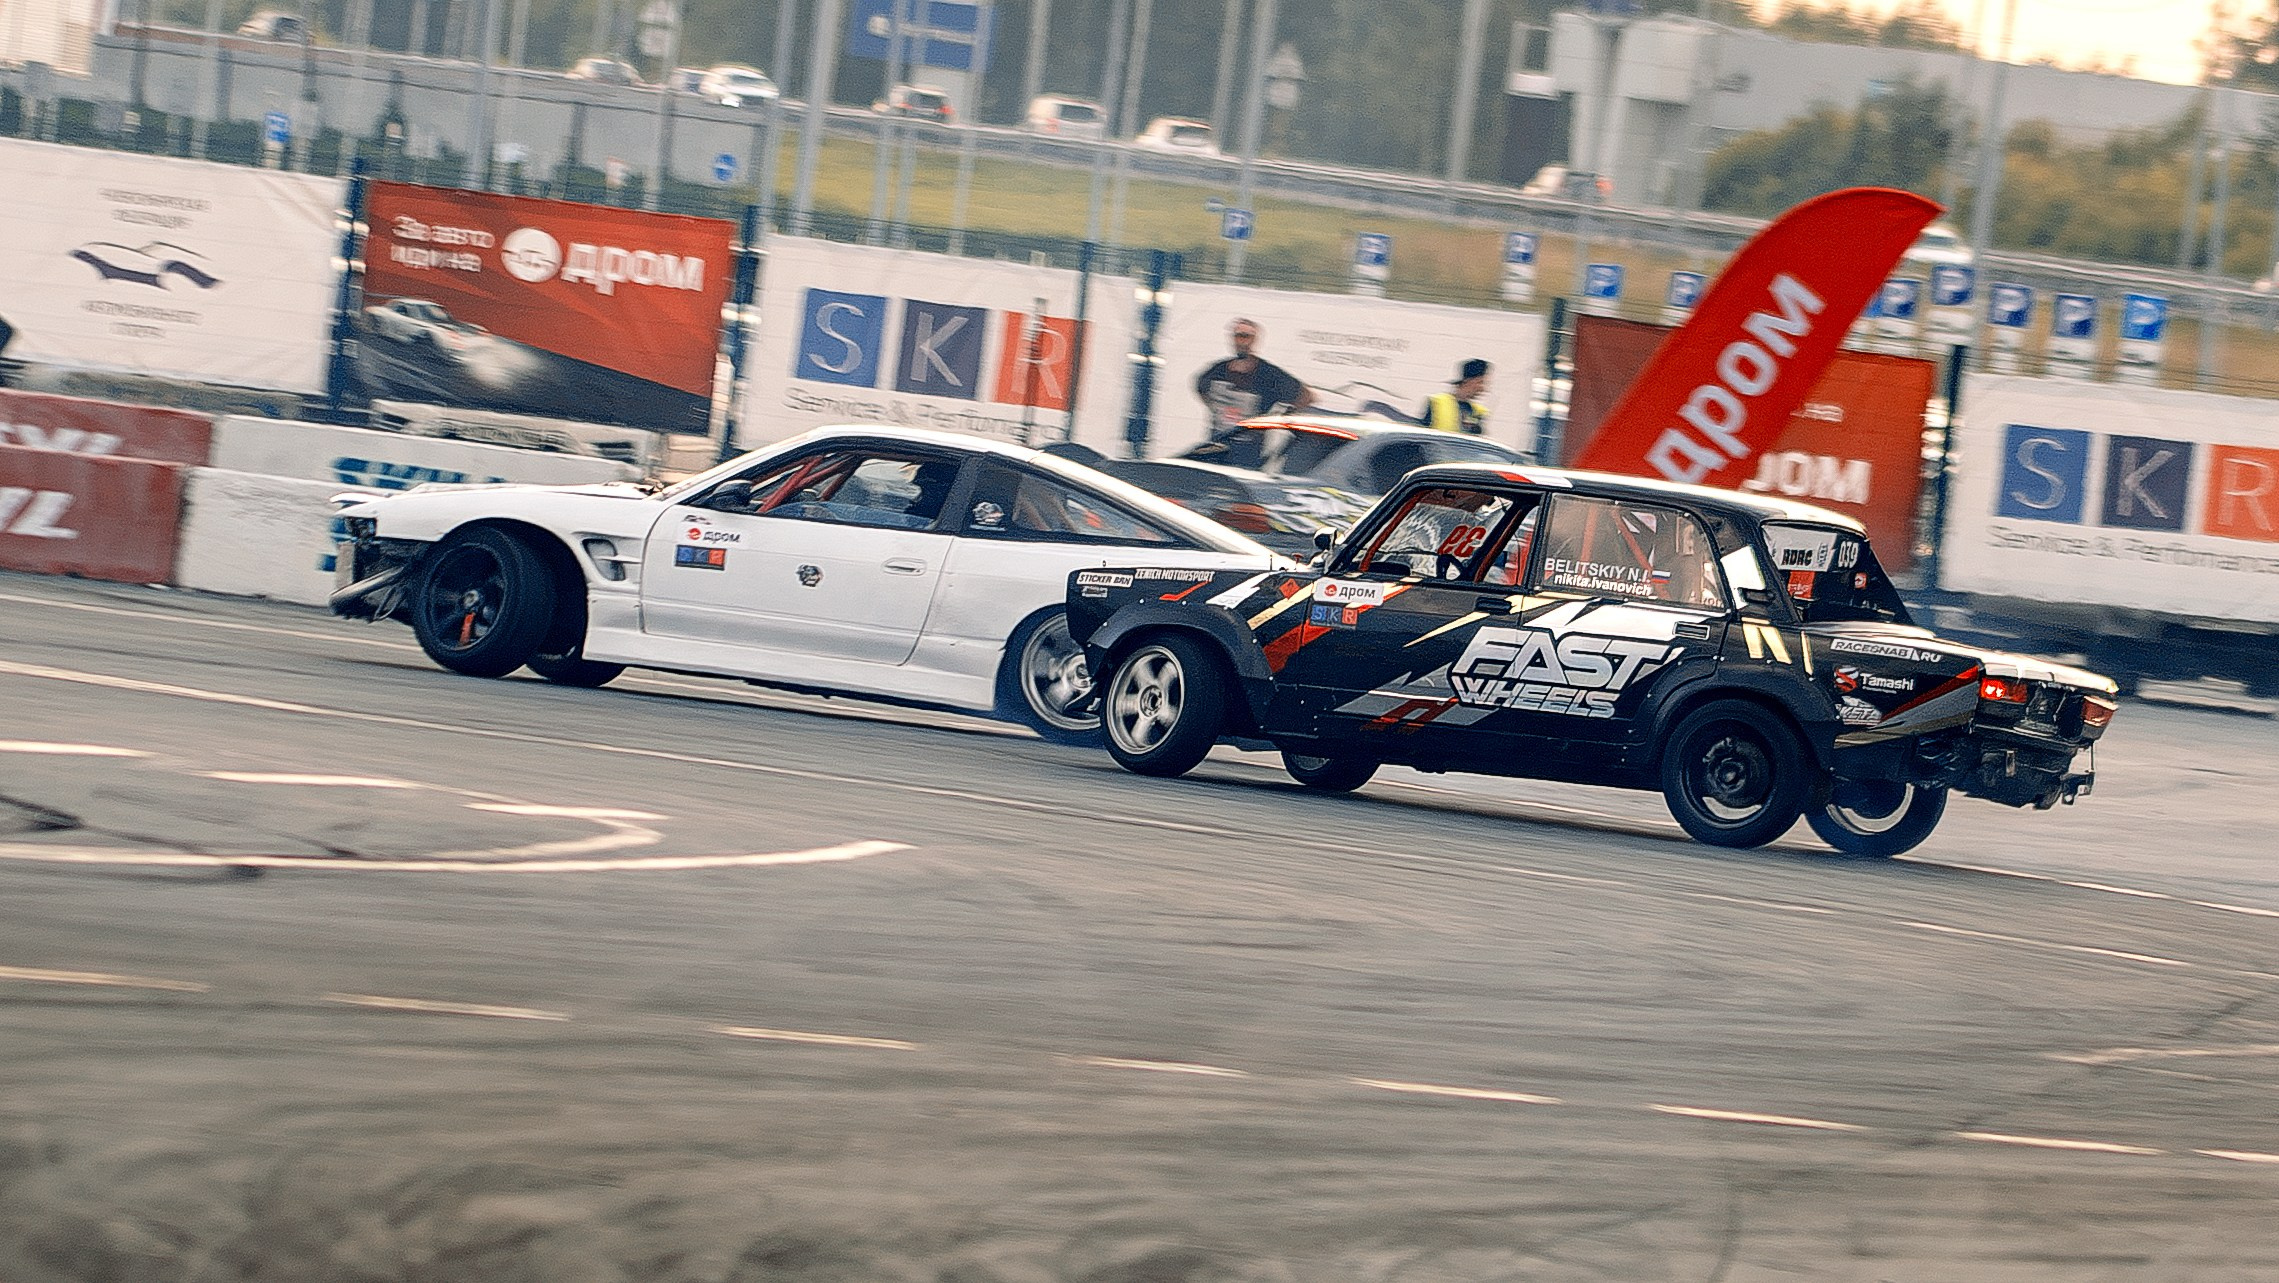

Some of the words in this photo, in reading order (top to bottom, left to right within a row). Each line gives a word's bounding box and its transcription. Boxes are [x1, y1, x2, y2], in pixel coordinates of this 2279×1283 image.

[1936, 269, 1964, 303] P
[1994, 288, 2023, 324] P
[2059, 297, 2088, 337] P
[2126, 298, 2156, 338] P
[1078, 574, 1112, 584] STICKER
[1544, 557, 1625, 579] BELITSKIY
[1339, 586, 1376, 600] дром
[1312, 604, 1356, 624] SKR
[1451, 625, 1671, 691] FAST
[1451, 676, 1620, 719] WHEELS
[1860, 673, 1914, 690] Tamashi
